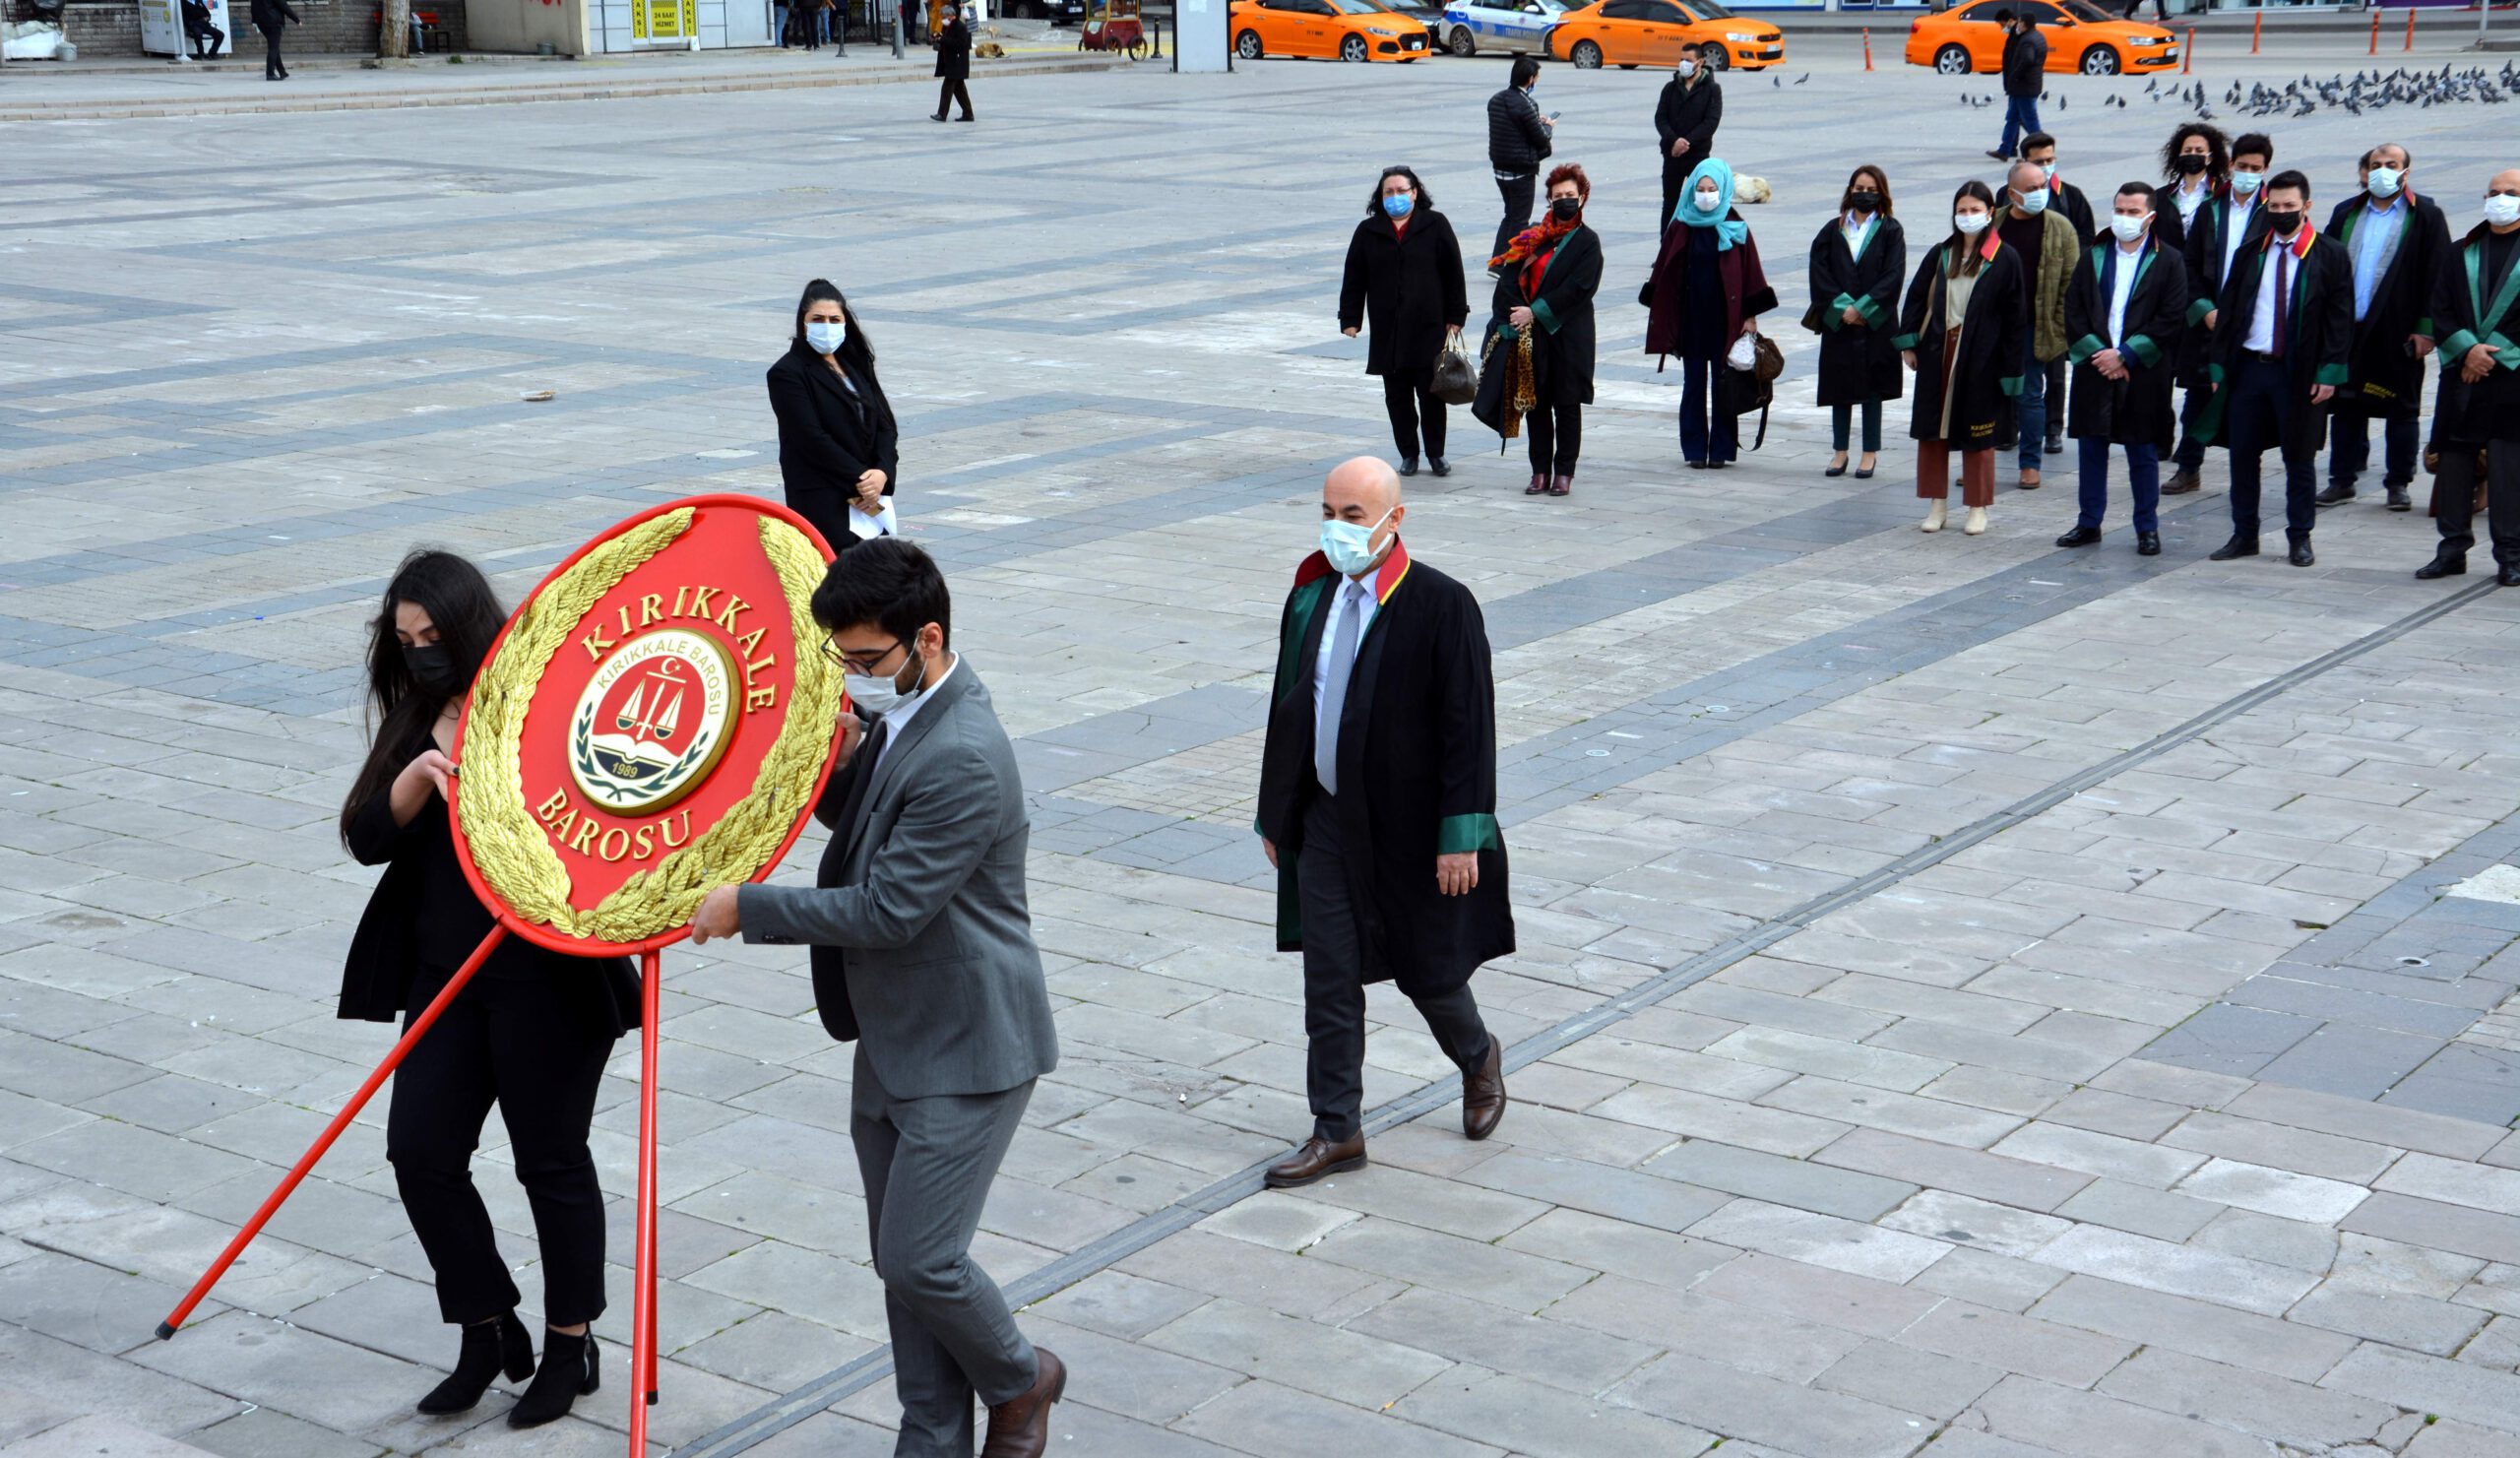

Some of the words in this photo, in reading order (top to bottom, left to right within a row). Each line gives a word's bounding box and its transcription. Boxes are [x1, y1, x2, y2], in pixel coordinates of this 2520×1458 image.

[581, 586, 777, 714] KIRIKKALE
[597, 639, 688, 689] KIRIKKALE
[690, 646, 723, 716] BAROSU
[612, 762, 638, 778] 1989
[536, 787, 692, 861] BAROSU
